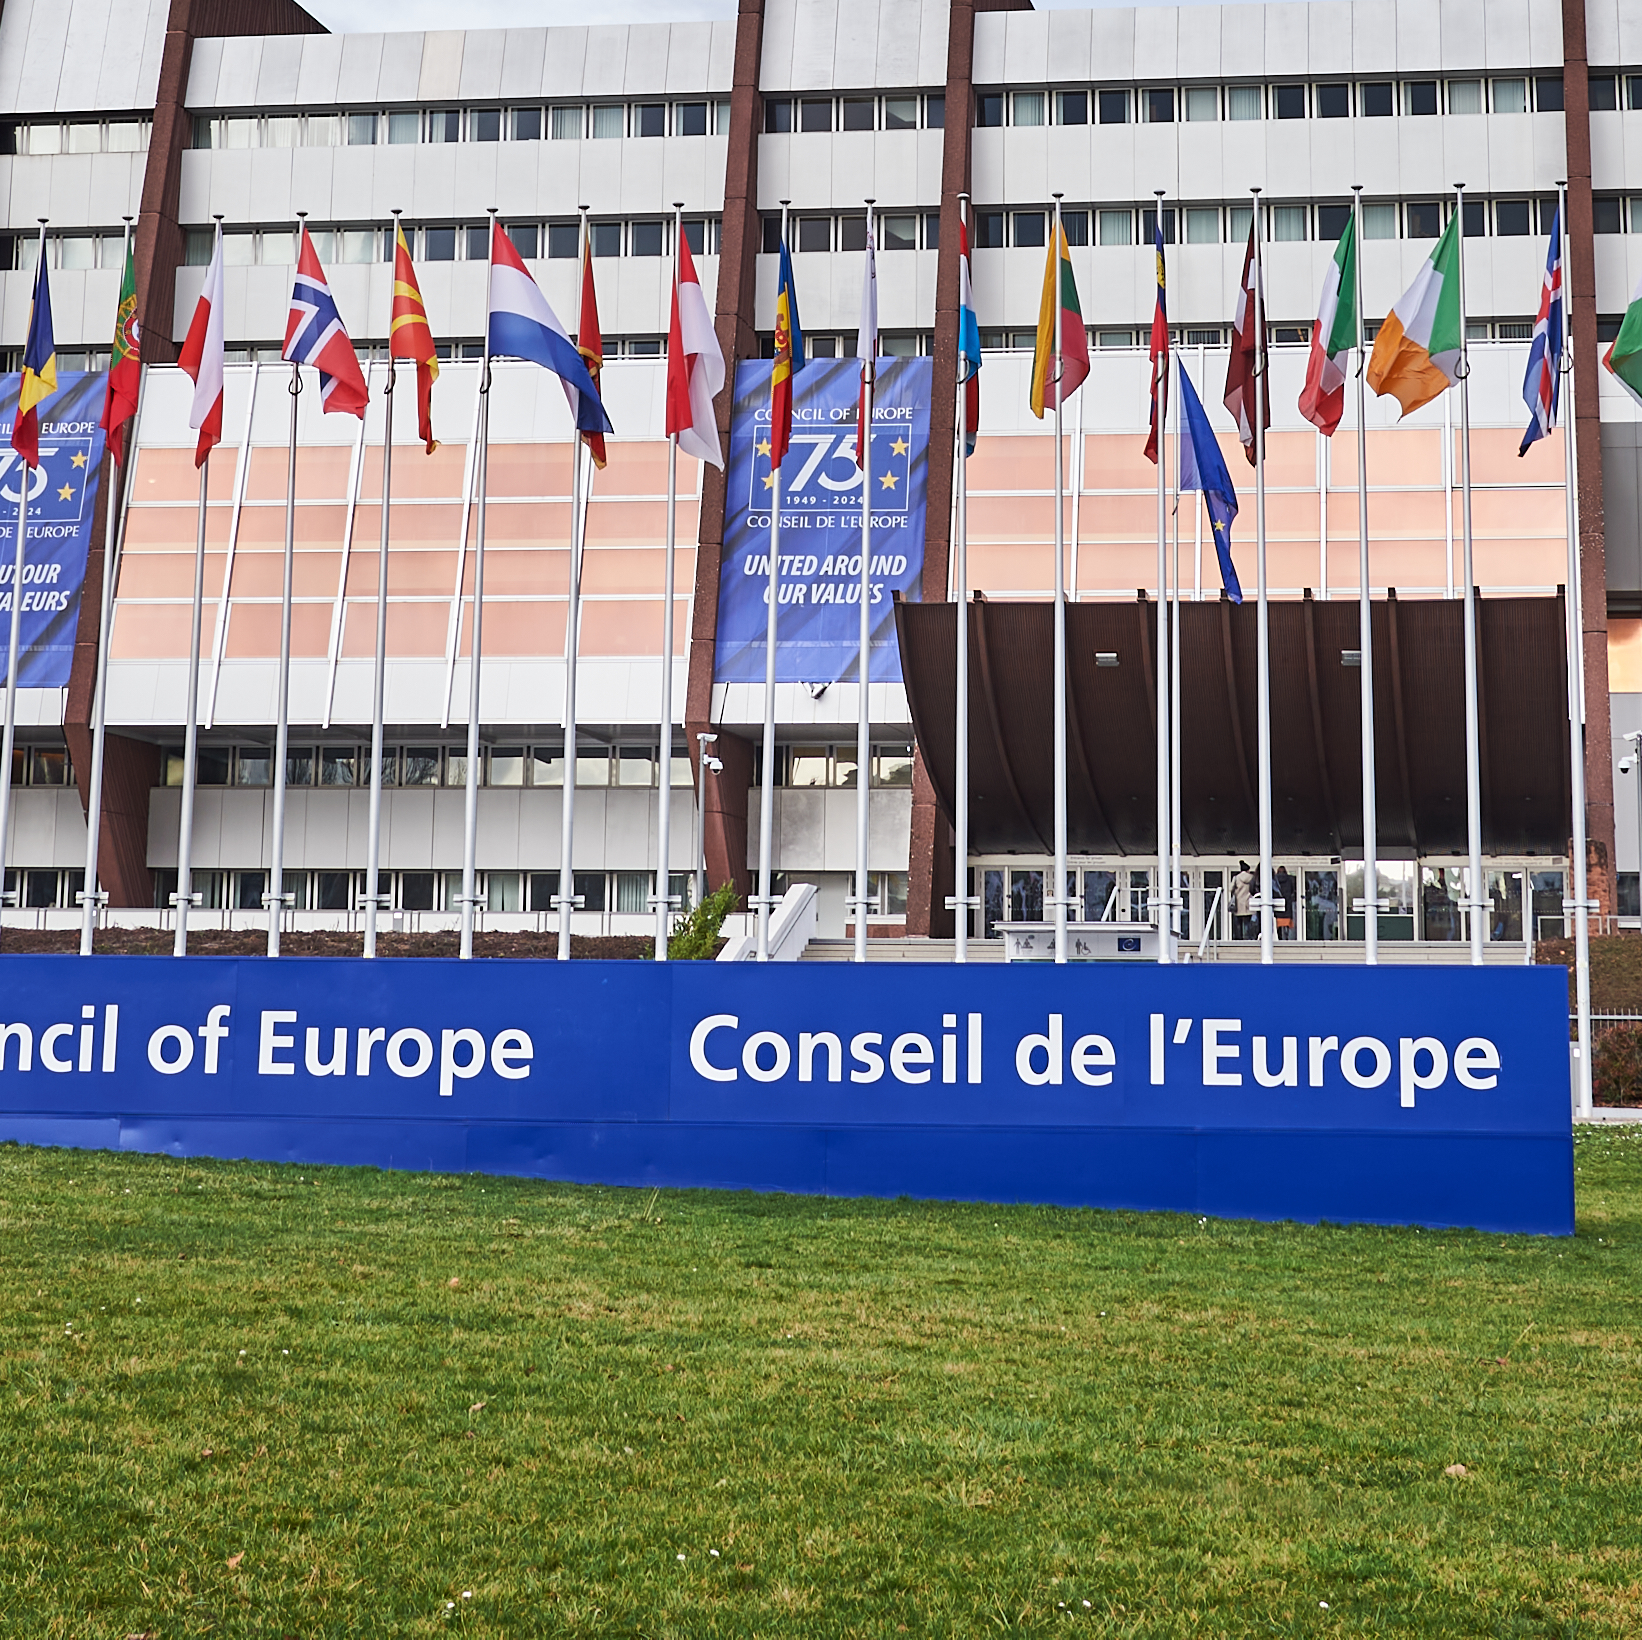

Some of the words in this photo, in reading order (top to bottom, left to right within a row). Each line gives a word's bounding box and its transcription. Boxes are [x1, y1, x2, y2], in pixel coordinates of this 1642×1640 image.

[754, 408, 825, 421] CONCIL
[829, 408, 851, 420] OF
[856, 407, 913, 420] ROPE
[41, 422, 95, 435] EUROPE
[788, 434, 877, 492] 75
[785, 496, 817, 505] 1949
[832, 496, 864, 505] 2024
[12, 507, 42, 516] 224
[746, 515, 812, 528] COSEIL
[816, 516, 836, 528] DE
[26, 525, 80, 538] EUROPE
[811, 583, 884, 604] VALUS
[146, 1003, 232, 1076] of
[256, 1009, 535, 1098] Europe
[688, 1012, 983, 1086] Conseil
[1014, 1012, 1117, 1088] de
